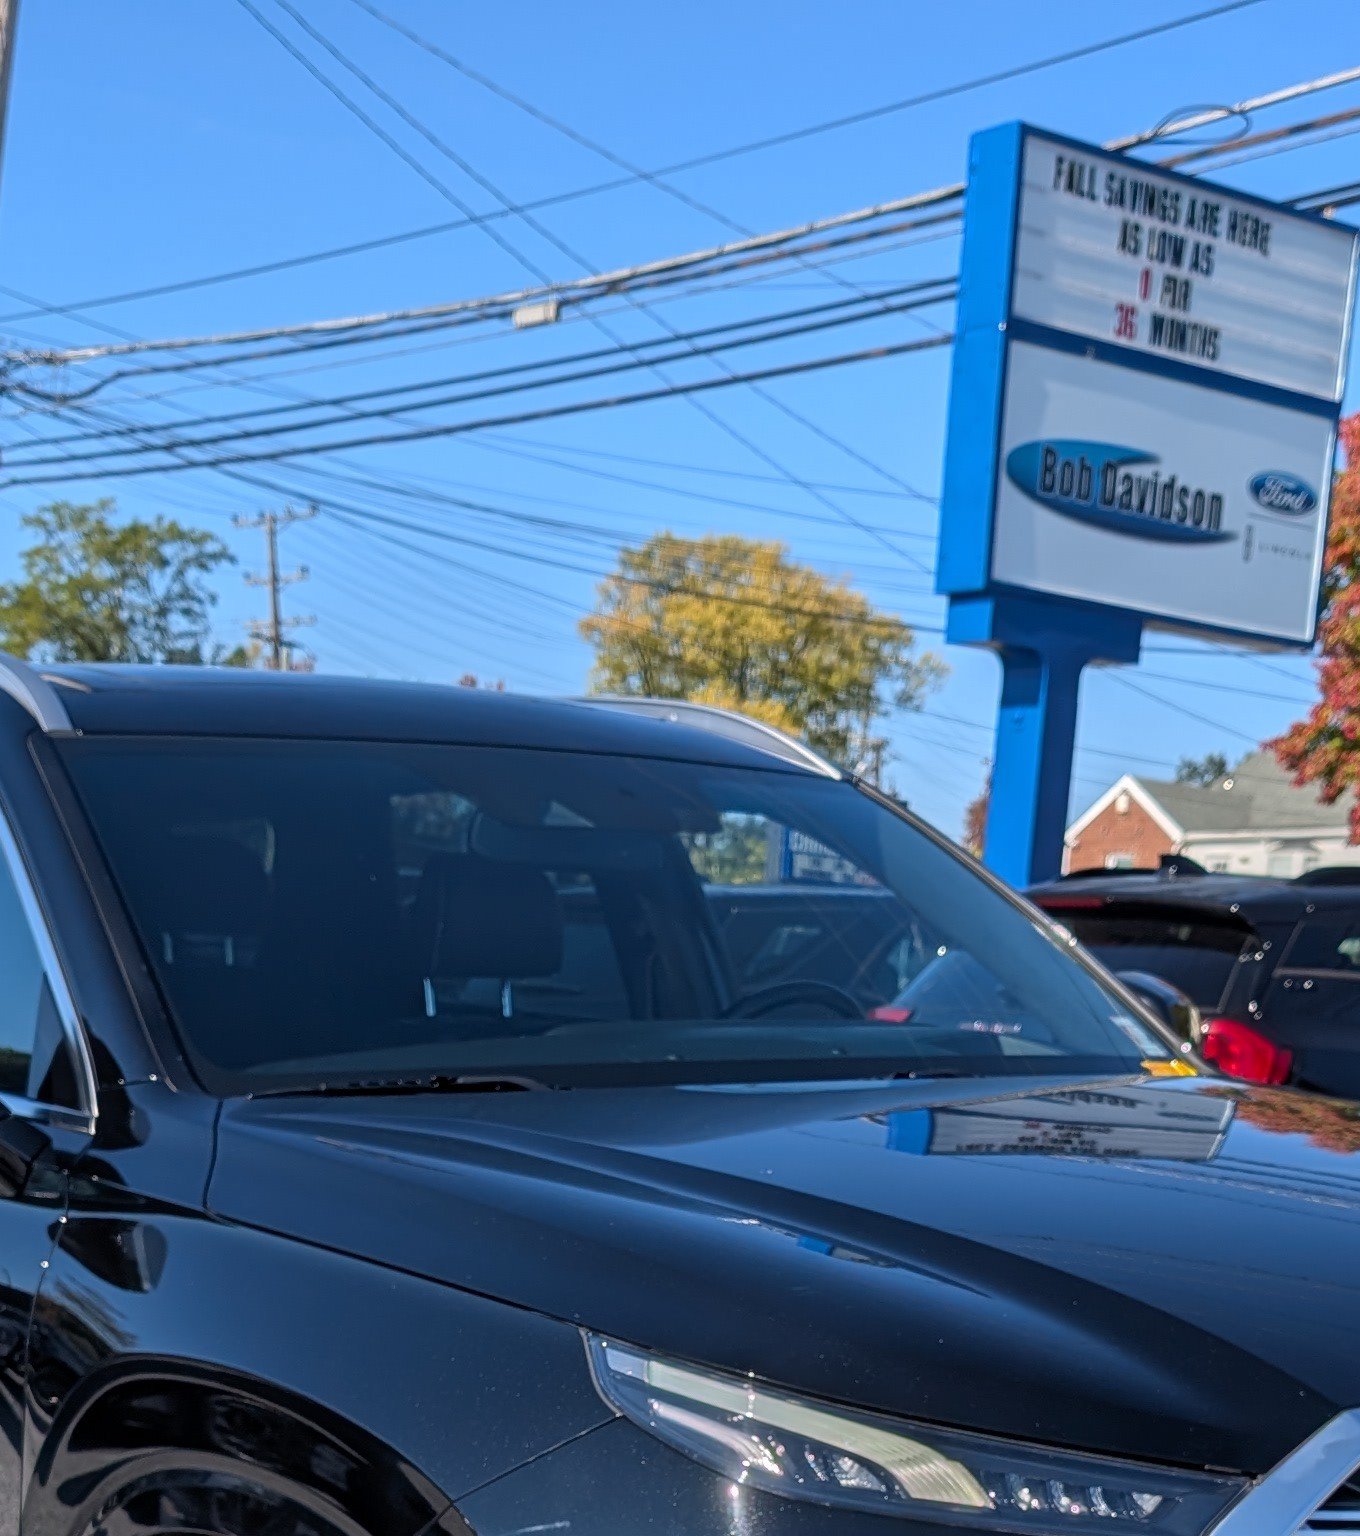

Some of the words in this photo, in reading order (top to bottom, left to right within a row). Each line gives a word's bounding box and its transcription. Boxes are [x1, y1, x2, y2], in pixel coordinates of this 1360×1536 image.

[1053, 155, 1097, 201] FALL
[1104, 171, 1181, 225] SAVINGS
[1185, 197, 1220, 238] ARE
[1226, 207, 1272, 257] HERE
[1117, 218, 1142, 256] AS
[1147, 226, 1187, 269] LOW
[1190, 241, 1215, 277] AS
[1160, 273, 1191, 313] FOR
[1115, 302, 1136, 341] 36
[1149, 312, 1221, 361] MONTHS
[1041, 446, 1092, 501] Bob
[1101, 460, 1223, 532] Davidson
